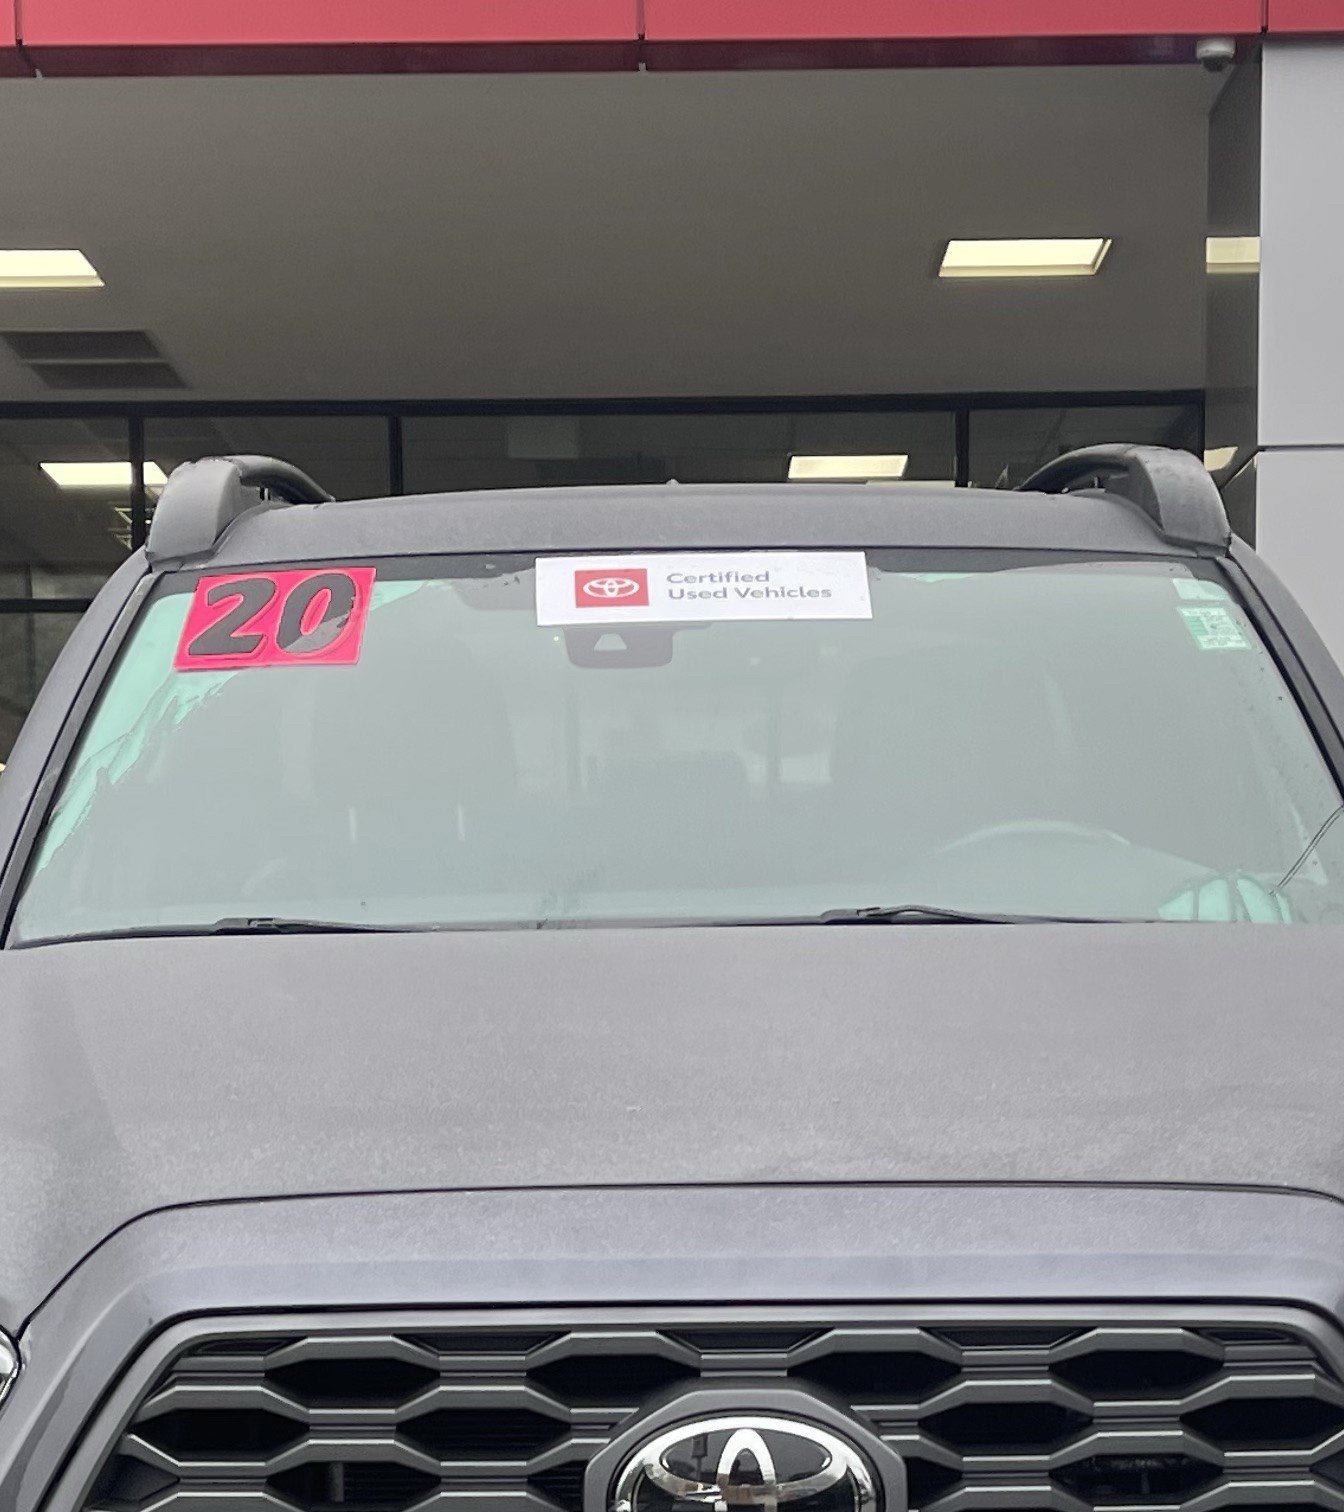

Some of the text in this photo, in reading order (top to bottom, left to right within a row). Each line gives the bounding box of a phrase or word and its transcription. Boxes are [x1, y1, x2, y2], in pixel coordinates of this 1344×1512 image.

[666, 571, 770, 584] Certified
[668, 586, 833, 600] Used Vehicles
[187, 573, 357, 656] 20
